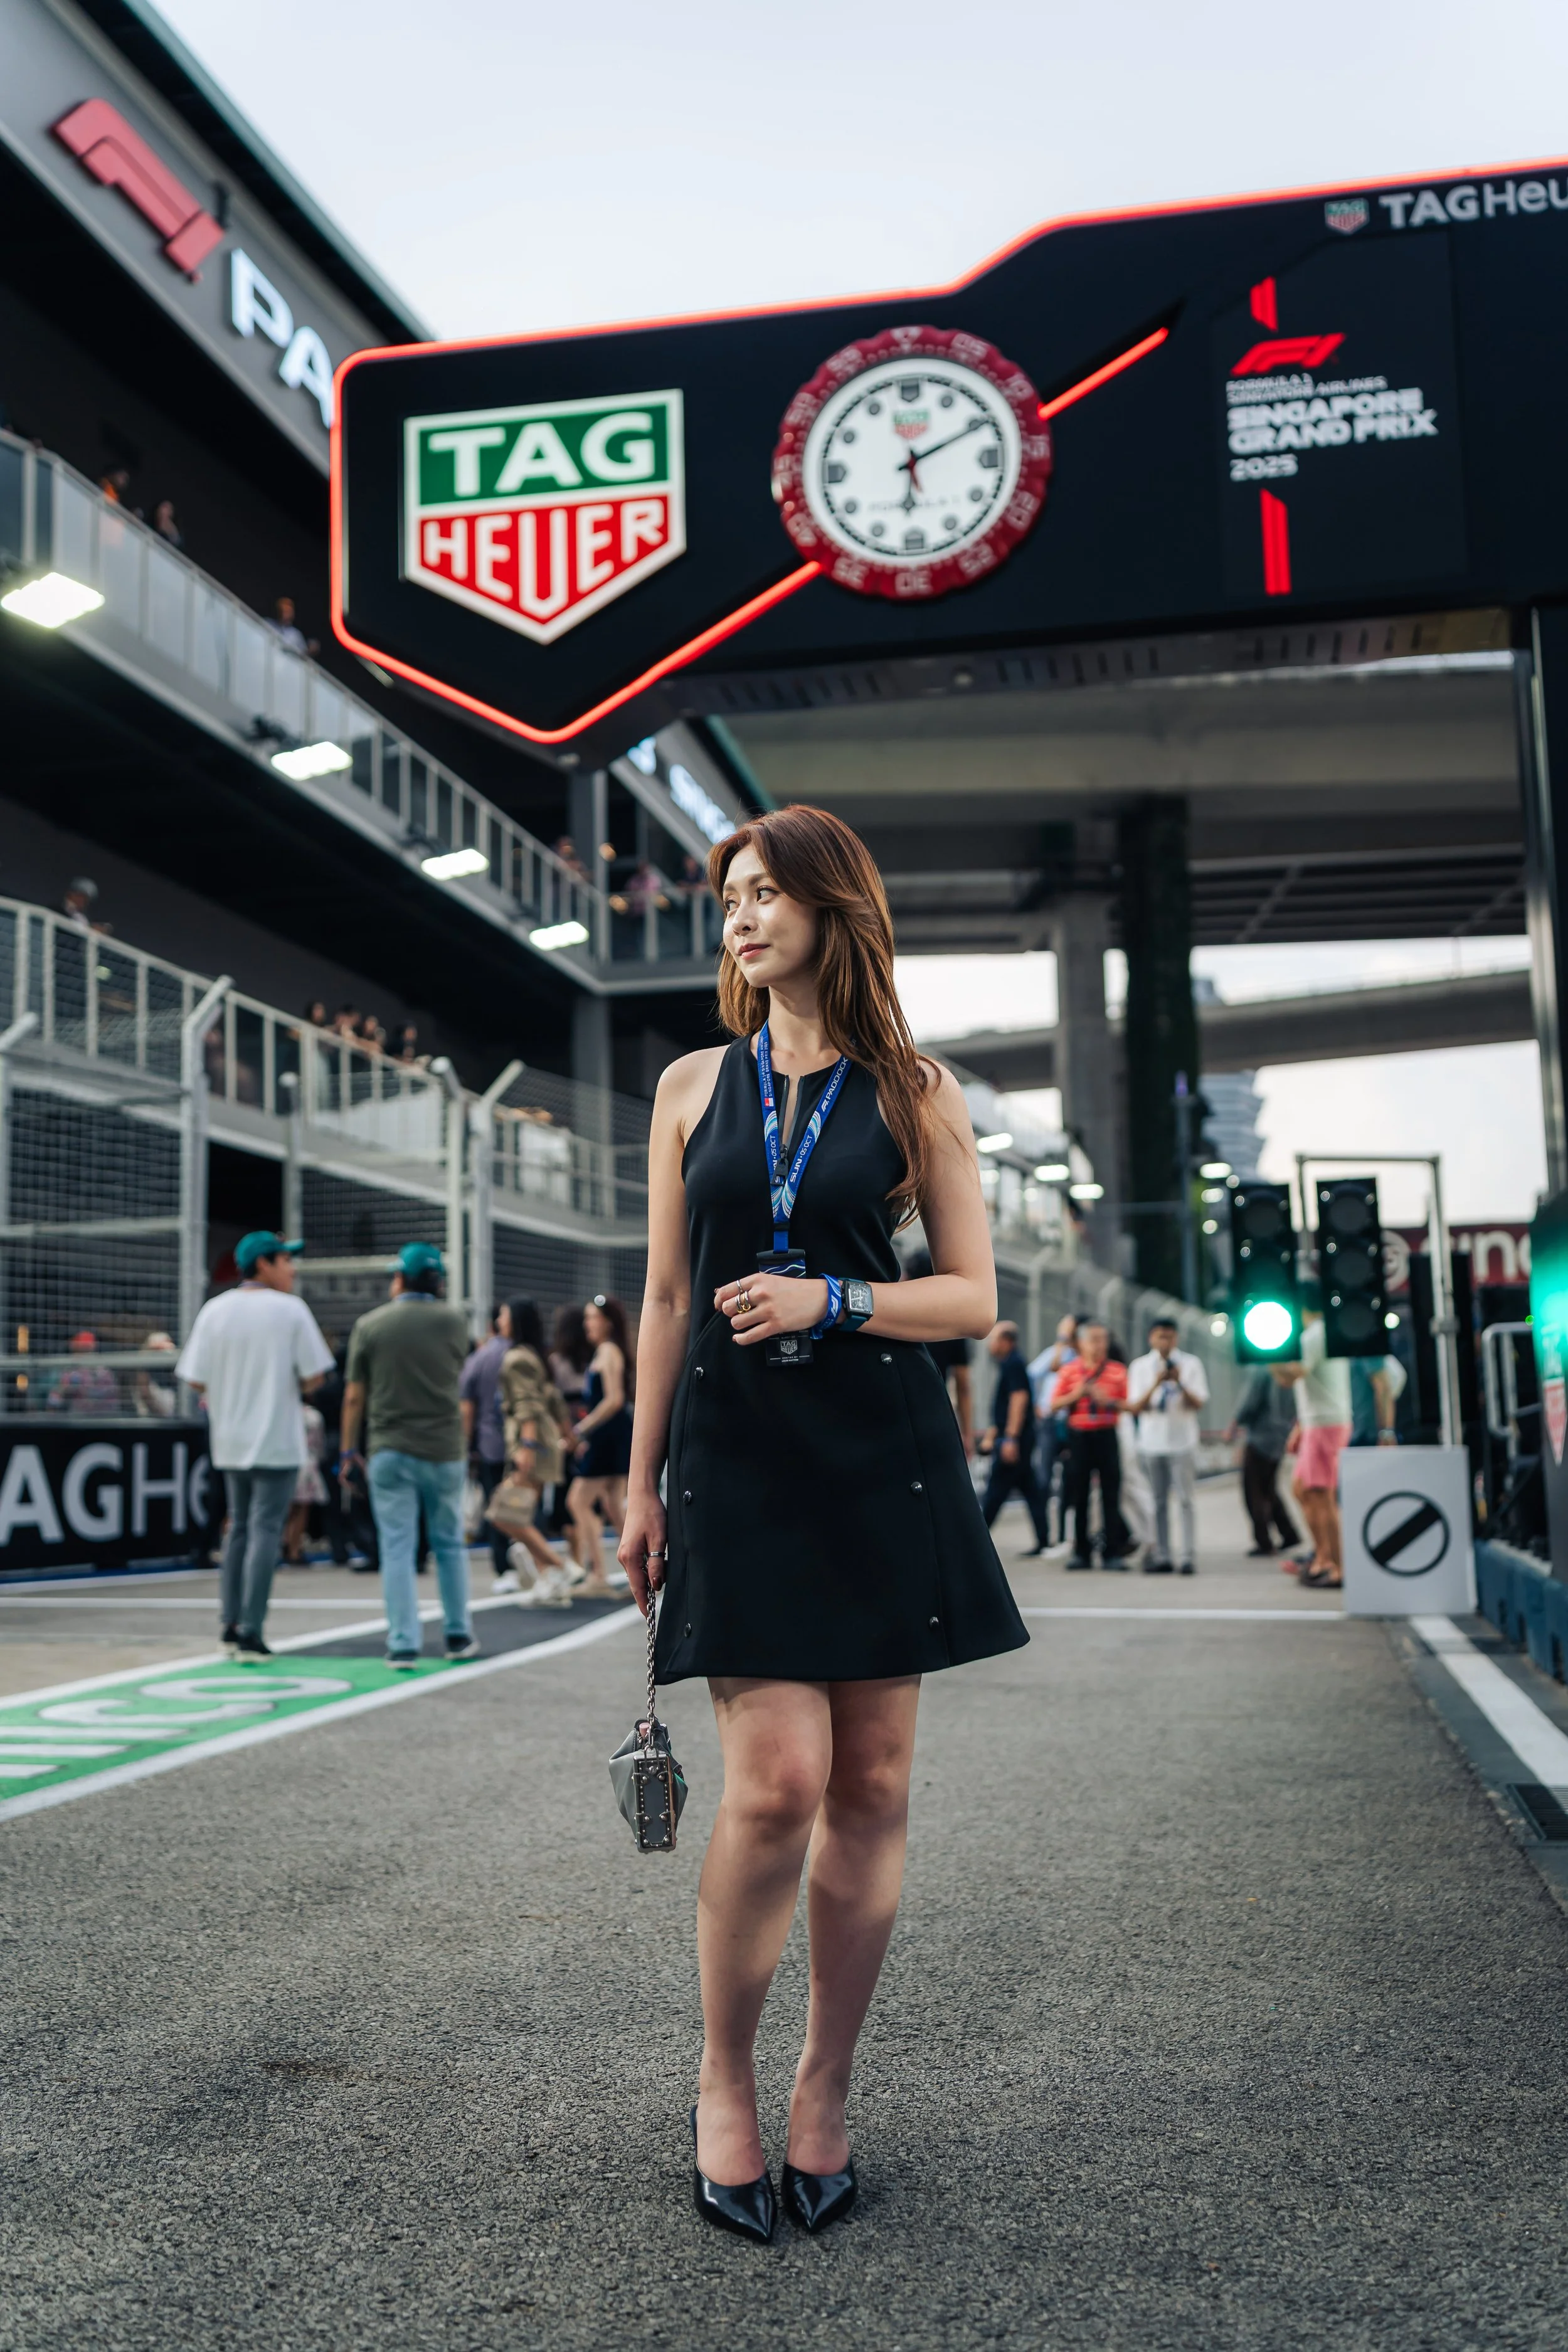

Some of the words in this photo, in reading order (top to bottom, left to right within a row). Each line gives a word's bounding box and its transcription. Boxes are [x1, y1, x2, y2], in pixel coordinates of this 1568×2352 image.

[1227, 387, 1424, 433] SINGAPORE
[1228, 418, 1352, 455] GRAND
[1353, 409, 1439, 443] PRIX
[428, 411, 655, 497] TAG
[1230, 453, 1298, 482] 2025
[423, 499, 664, 619] HEUER
[826, 1057, 848, 1100] PADDOCK
[790, 1158, 802, 1183] SUN
[781, 1346, 797, 1354] HEUER
